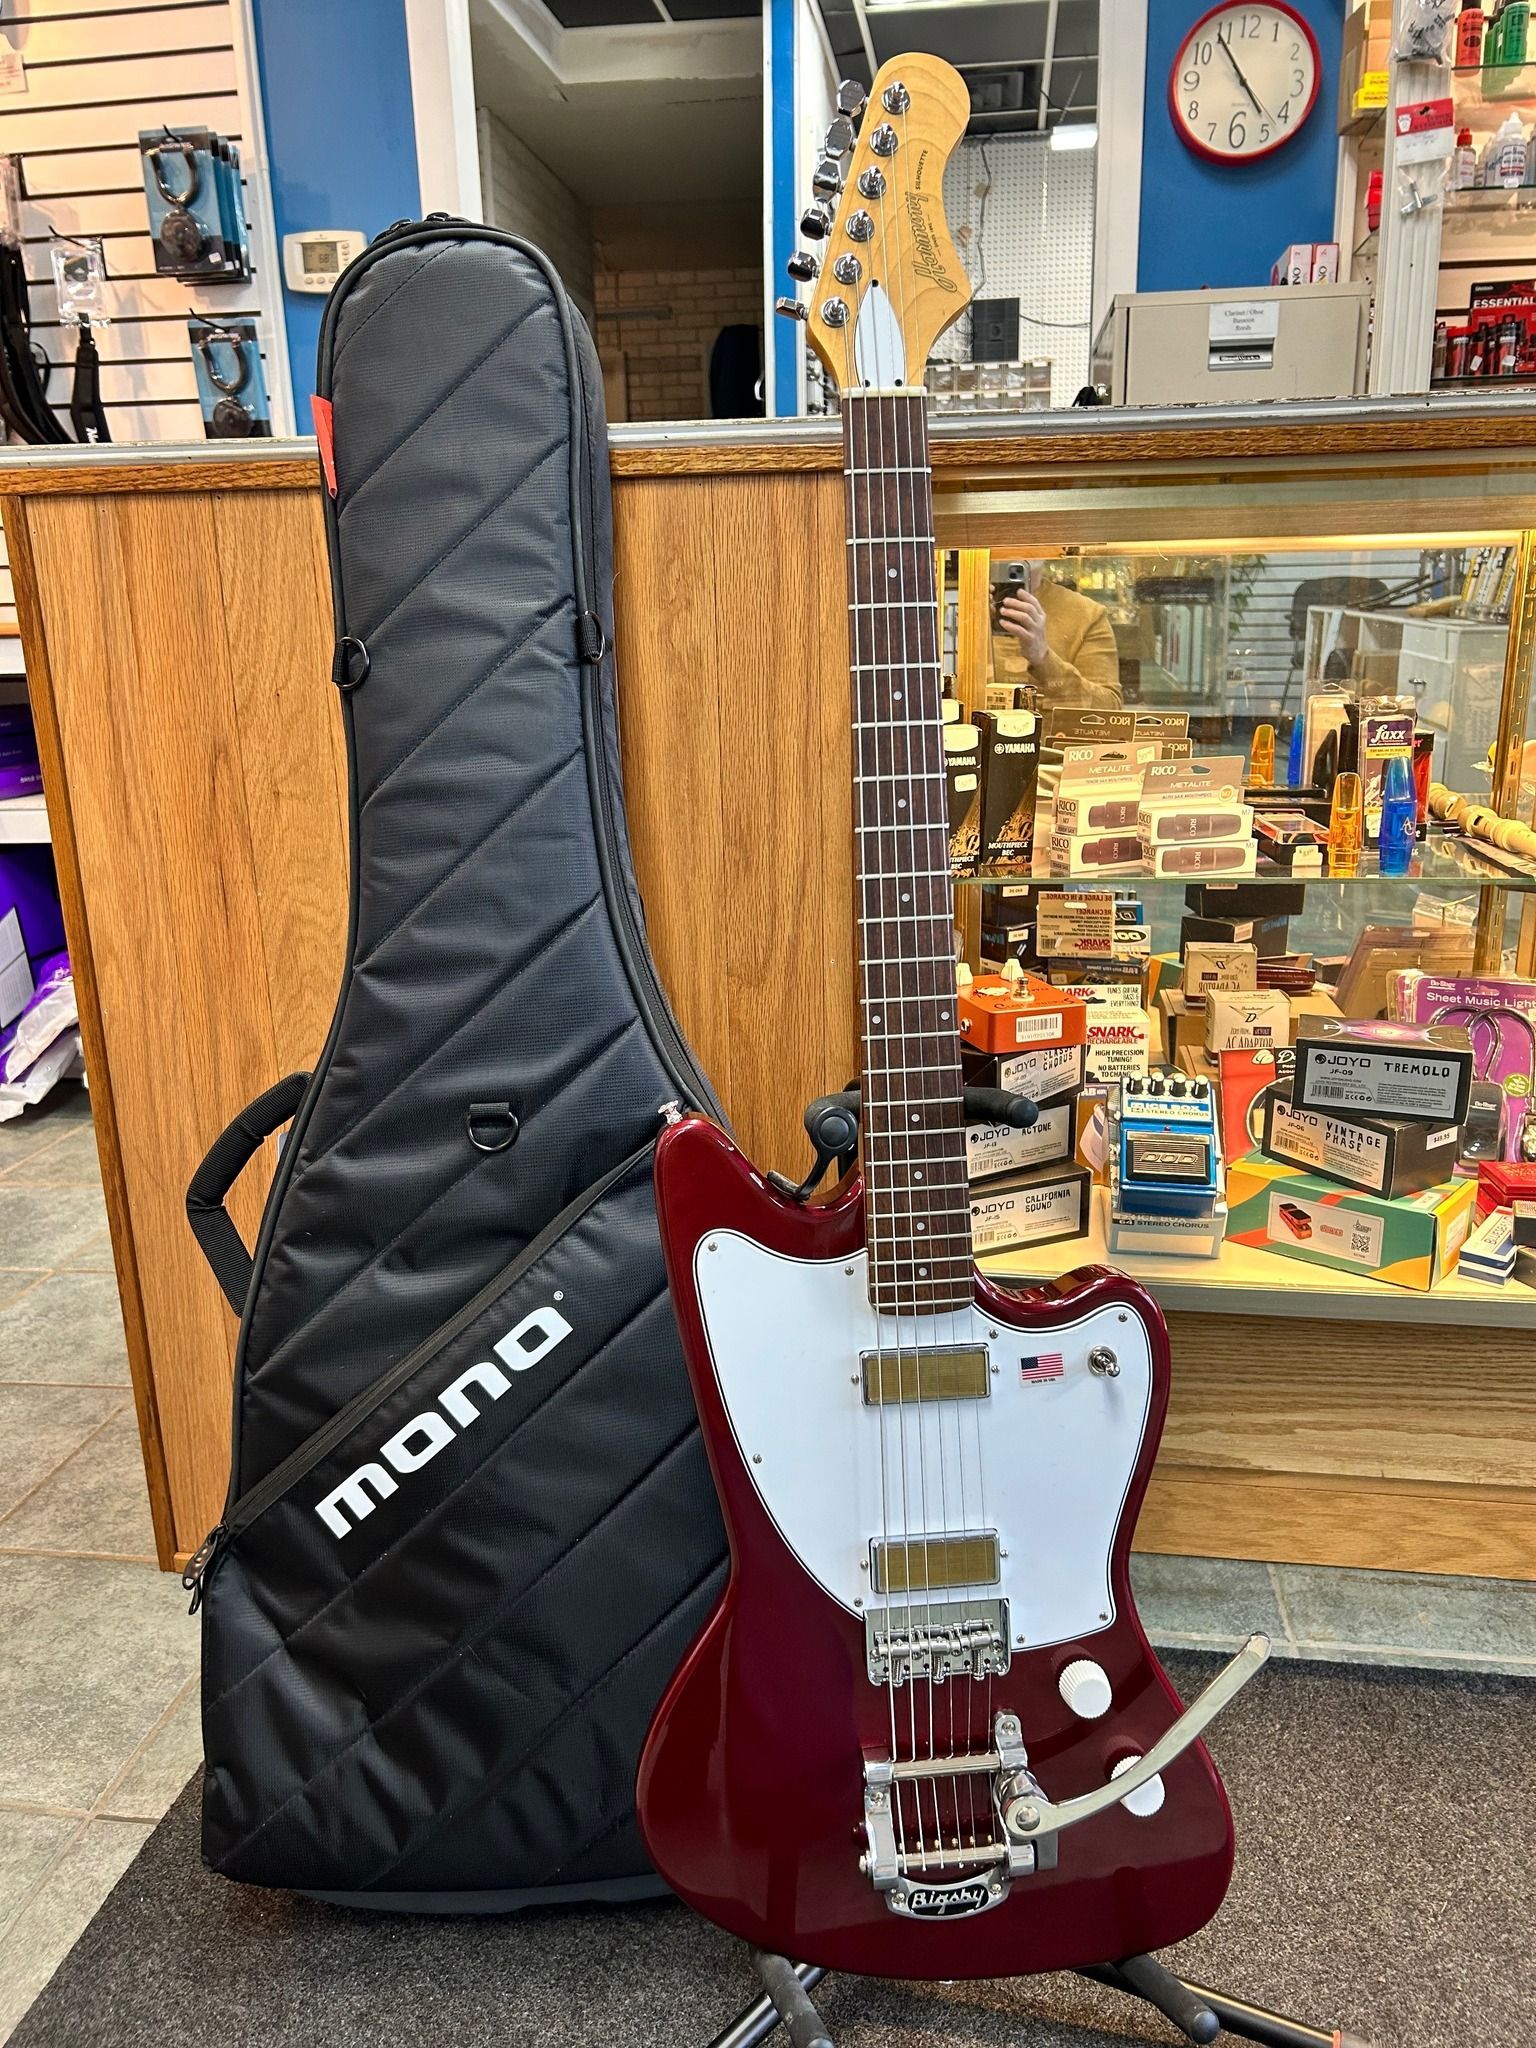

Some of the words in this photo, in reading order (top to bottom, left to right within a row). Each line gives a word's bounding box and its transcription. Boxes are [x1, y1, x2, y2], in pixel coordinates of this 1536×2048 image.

[1217, 22, 1232, 45] 11
[1240, 14, 1261, 39] 12
[1272, 22, 1279, 42] 1
[1193, 41, 1212, 66] 10
[1290, 42, 1300, 61] 2
[1183, 70, 1200, 92] 9
[1290, 69, 1304, 98] 3
[1188, 100, 1199, 120] 8
[1277, 100, 1289, 124] 4
[1207, 122, 1217, 141] 7
[1229, 111, 1246, 149] 6
[1259, 123, 1270, 143] 5
[915, 149, 928, 190] SILHOUETTE
[904, 191, 958, 293] Harmony
[1370, 724, 1406, 744] faxx
[1005, 743, 1035, 753] YAMAHA
[1069, 750, 1093, 760] RICO
[948, 757, 976, 766] YAMAHA
[1088, 765, 1133, 774] METALITE
[1151, 765, 1176, 776] RICO
[1169, 780, 1214, 789] METALITE
[1059, 800, 1077, 812] RICO
[988, 841, 1028, 849] MOUTHPIECE
[1051, 836, 1070, 848] RICO
[1001, 849, 1014, 857] BEC
[1194, 851, 1202, 870] RICO
[1426, 992, 1462, 1003] Sheet
[1465, 996, 1501, 1006] Music
[1087, 1026, 1142, 1039] SNARK
[1226, 1036, 1237, 1048] AC
[1012, 1058, 1037, 1075] JOYO
[1043, 1052, 1073, 1071] CHORUS
[1328, 1055, 1371, 1068] JOYO
[1384, 1062, 1451, 1078] TREMOLO
[1286, 1109, 1318, 1126] JOYO
[980, 1127, 1010, 1141] JOYO
[1287, 1122, 1305, 1132] JF-06
[1326, 1121, 1381, 1148] VINTAGE
[1325, 1132, 1362, 1152] PHASE
[1139, 1151, 1199, 1165] DOD
[1025, 1189, 1071, 1204] CALIFORNIA
[981, 1200, 1015, 1214] JOYO
[1025, 1201, 1052, 1213] SOUND
[1172, 1221, 1209, 1229] CHORUS
[315, 1306, 574, 1540] mono
[911, 1888, 985, 1915] Bigsby
